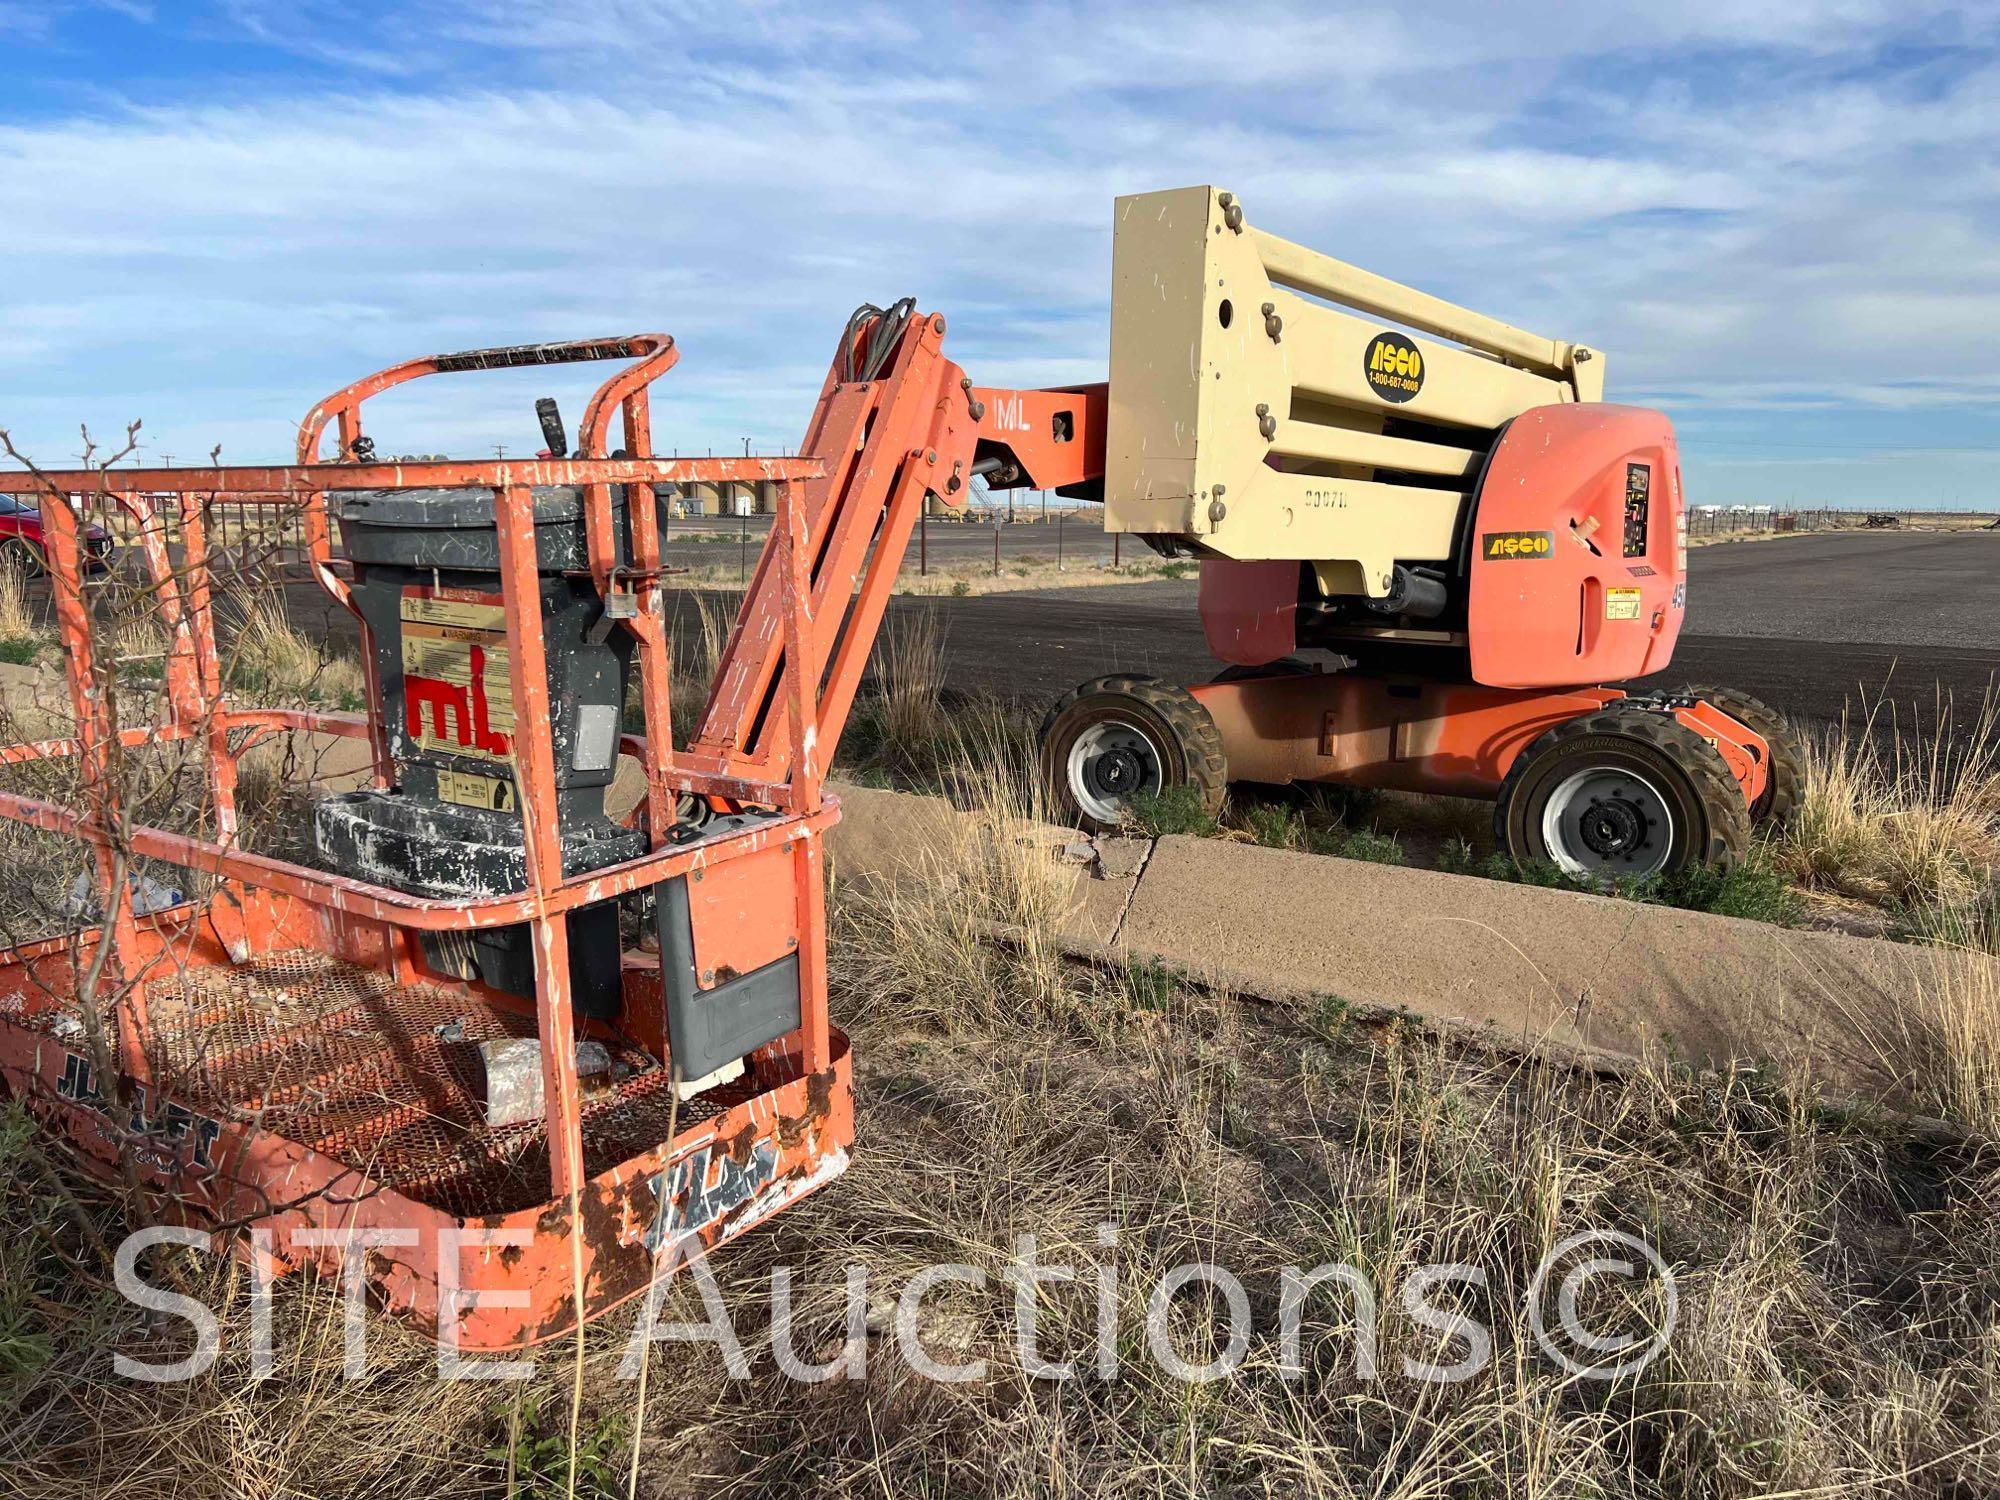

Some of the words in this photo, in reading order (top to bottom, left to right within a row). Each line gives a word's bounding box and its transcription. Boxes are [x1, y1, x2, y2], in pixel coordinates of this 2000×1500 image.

[1370, 341, 1420, 379] ASCO
[1489, 537, 1549, 555] ASCO
[447, 629, 482, 641] WARNING
